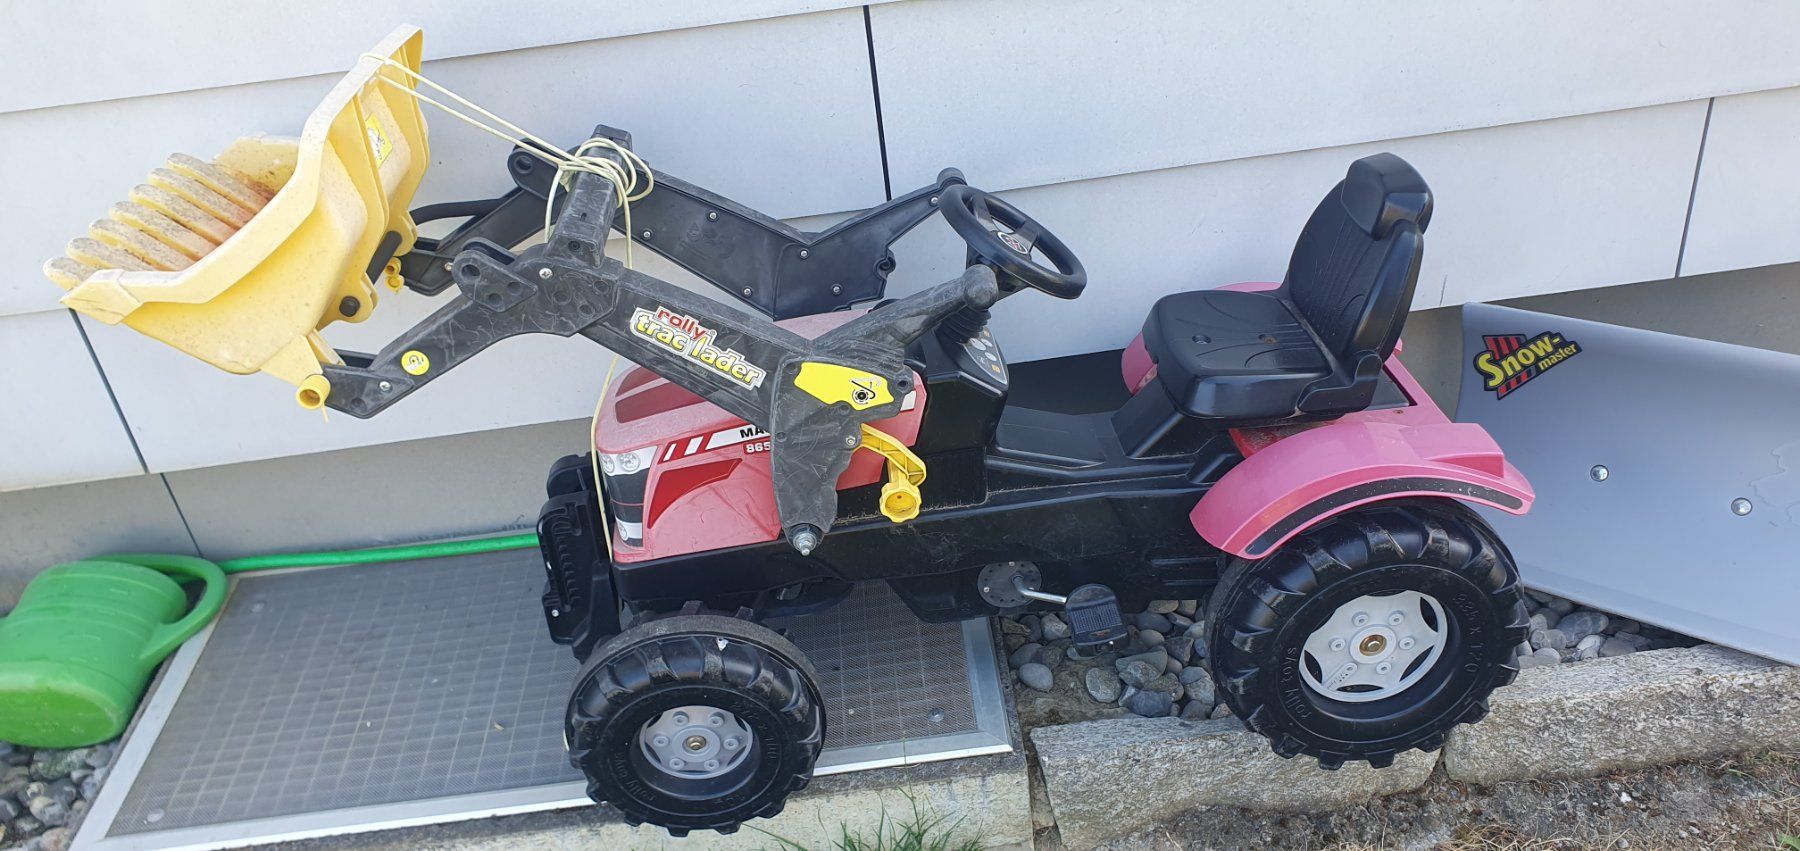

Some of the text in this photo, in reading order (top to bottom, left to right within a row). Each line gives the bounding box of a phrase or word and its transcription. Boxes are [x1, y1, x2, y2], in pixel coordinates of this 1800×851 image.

[636, 314, 760, 384] trac lader
[1478, 335, 1562, 387] Snow-
[1538, 343, 1577, 371] master
[740, 426, 769, 438] MA
[1284, 687, 1313, 719] rolly
